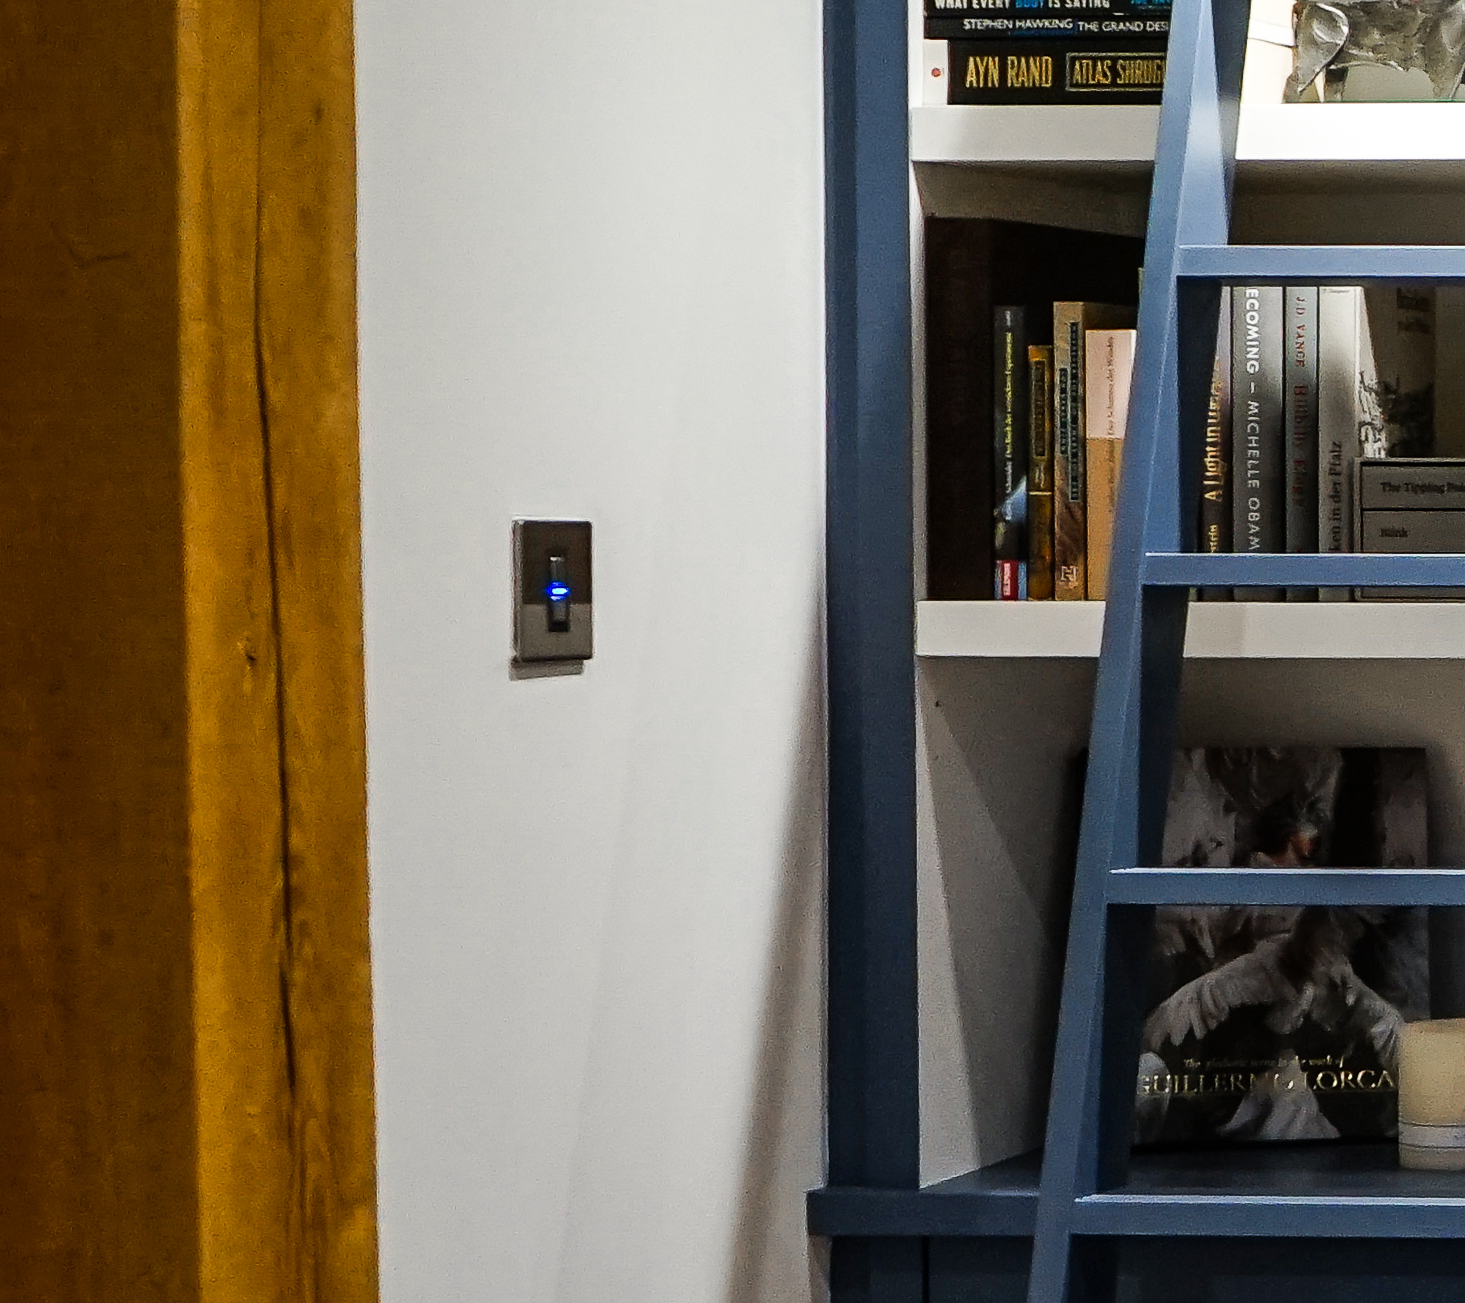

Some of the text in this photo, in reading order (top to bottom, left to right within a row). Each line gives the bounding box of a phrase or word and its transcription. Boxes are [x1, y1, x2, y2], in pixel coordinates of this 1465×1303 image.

[966, 56, 1052, 87] AYN RAND
[1073, 60, 1112, 84] ATLAS
[1246, 289, 1259, 374] ECOMING
